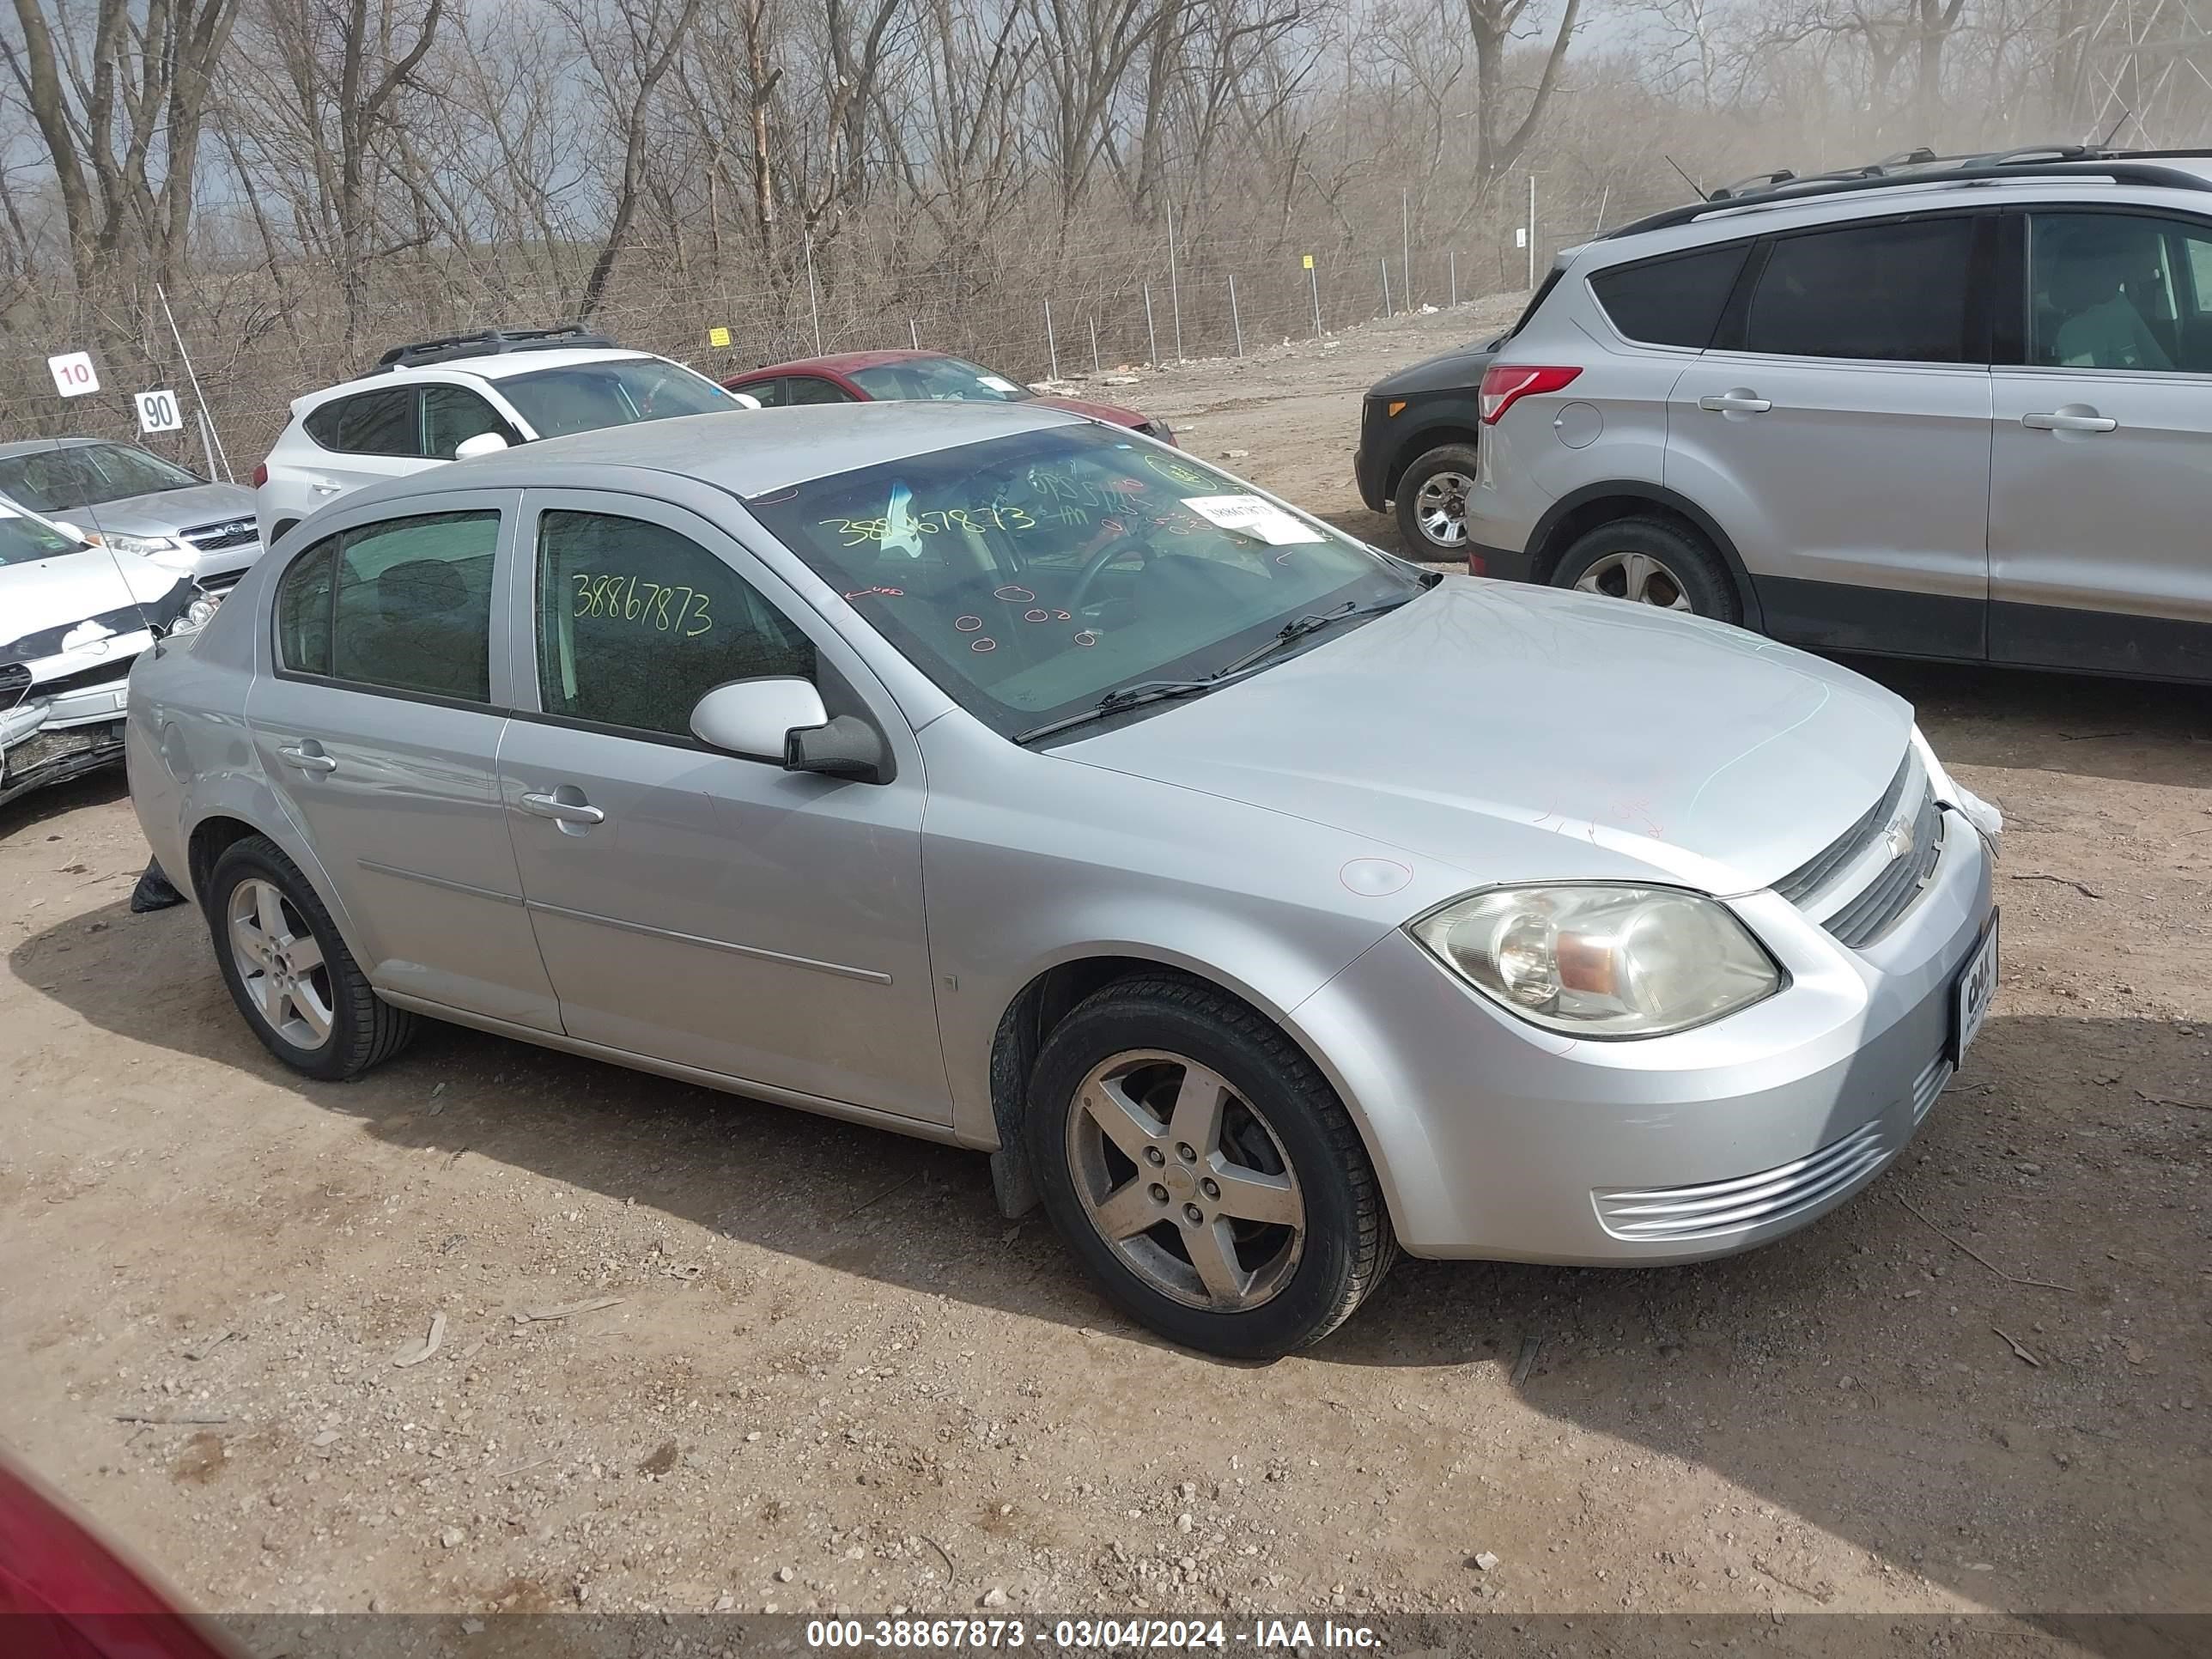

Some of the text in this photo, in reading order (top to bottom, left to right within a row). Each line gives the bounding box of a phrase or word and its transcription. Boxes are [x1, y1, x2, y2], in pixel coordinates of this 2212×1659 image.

[60, 363, 89, 386] 10
[143, 395, 173, 428] 90
[818, 507, 1036, 547] 38867873
[573, 574, 714, 637] 38867873
